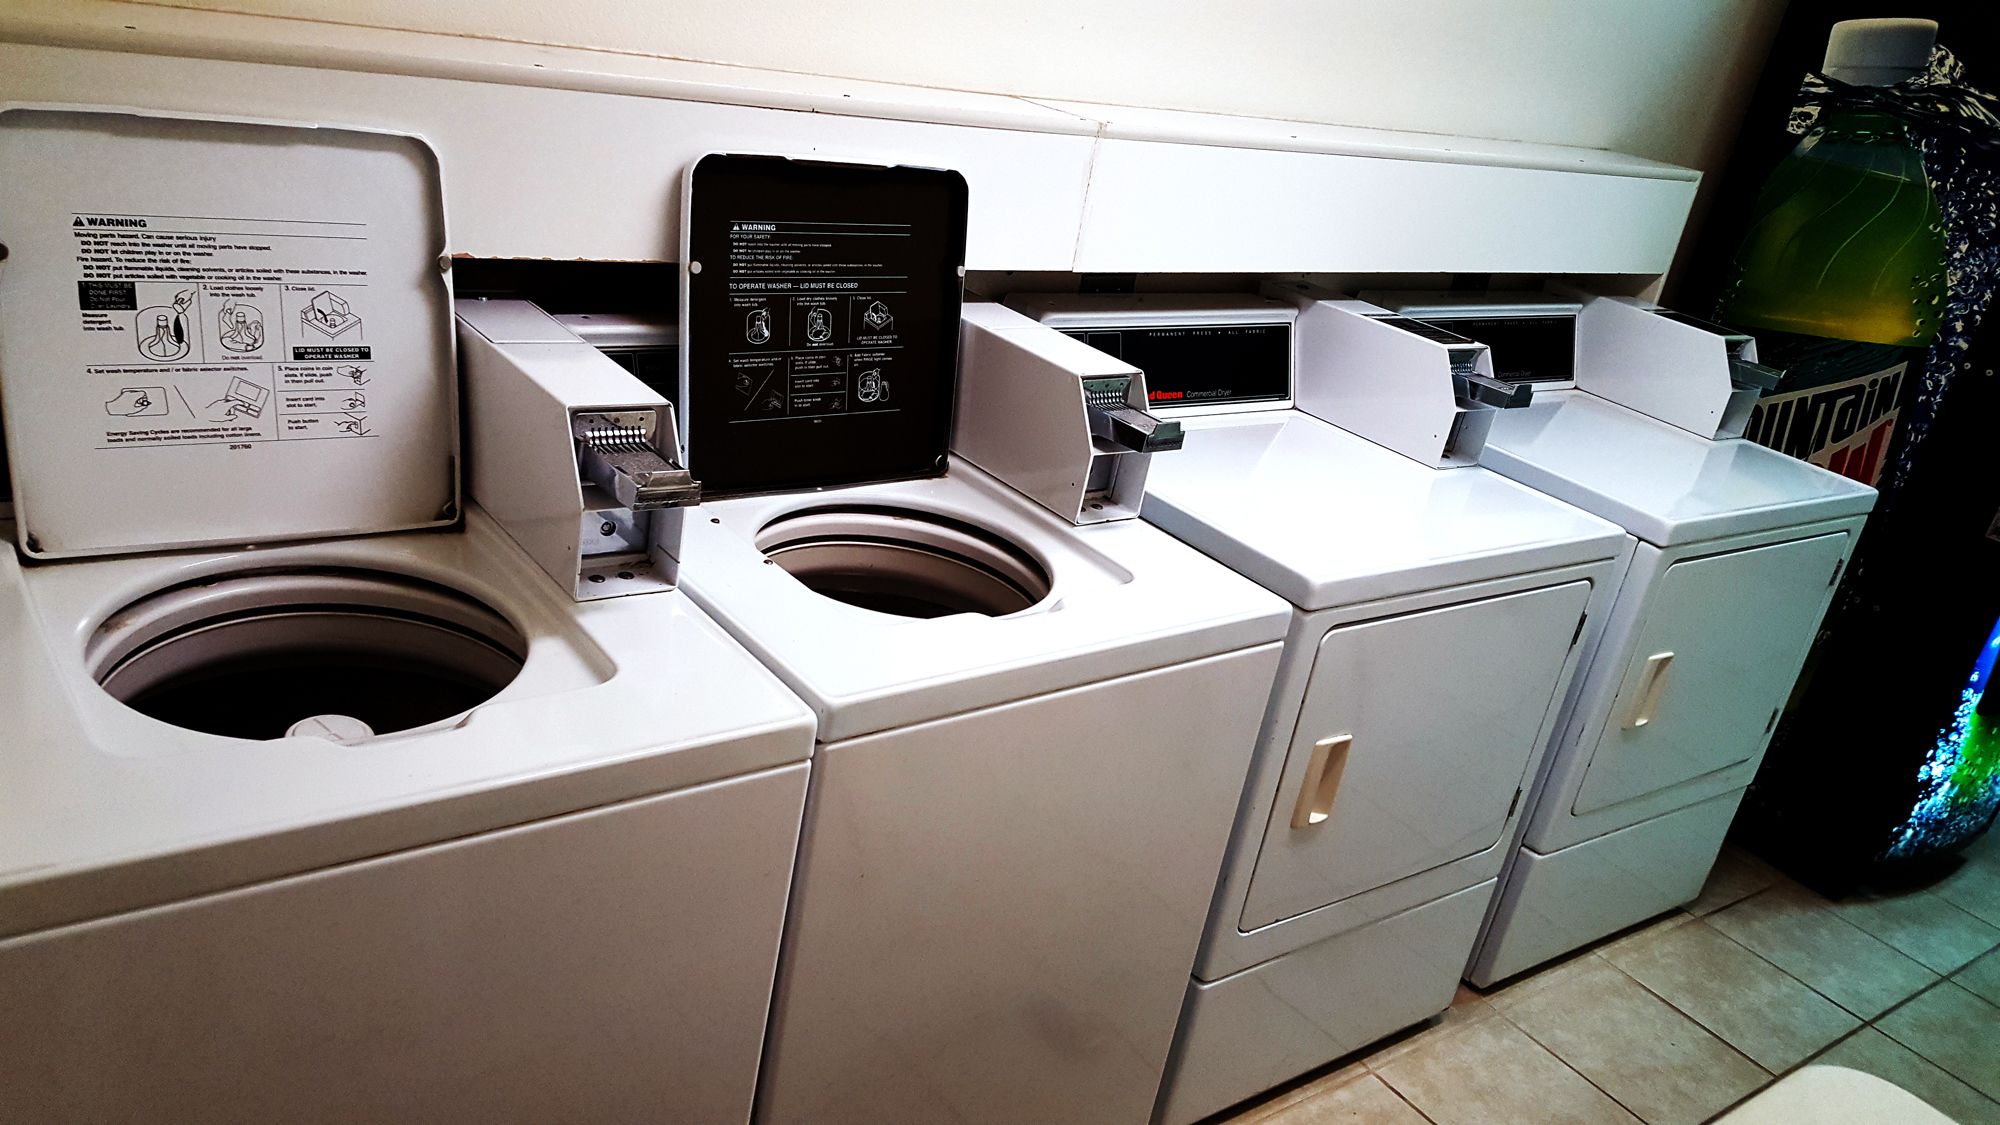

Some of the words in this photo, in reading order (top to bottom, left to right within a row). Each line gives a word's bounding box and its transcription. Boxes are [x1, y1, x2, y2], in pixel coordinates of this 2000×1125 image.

[86, 217, 147, 228] WARNING
[74, 232, 98, 240] Moving
[1156, 390, 1183, 399] Queen
[1186, 390, 1217, 398] Commercial
[1218, 388, 1232, 396] Dryer
